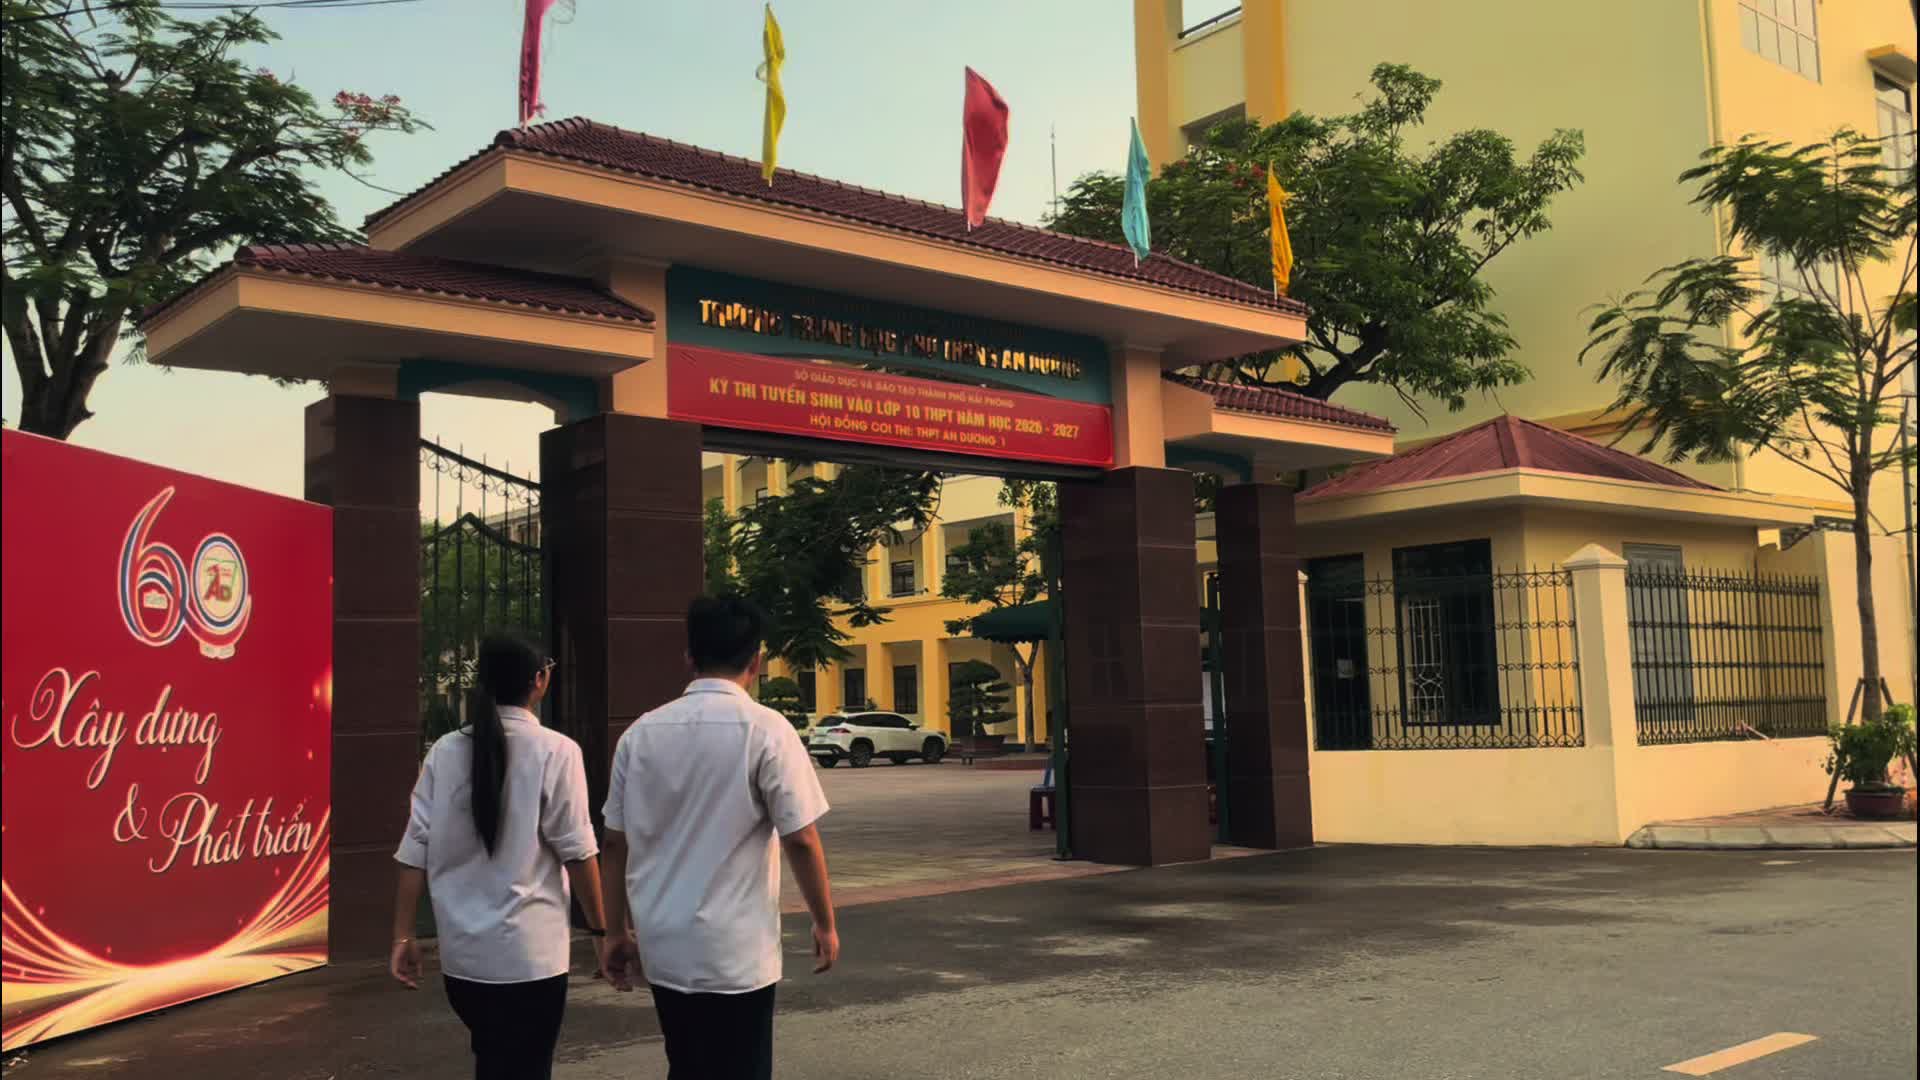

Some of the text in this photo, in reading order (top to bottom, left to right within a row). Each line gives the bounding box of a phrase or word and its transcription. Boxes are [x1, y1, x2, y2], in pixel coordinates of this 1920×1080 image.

[1001, 348, 1026, 371] AN
[733, 381, 757, 400] THI
[809, 391, 843, 409] SINH
[905, 404, 920, 419] 10
[924, 405, 953, 425] THPT
[956, 408, 986, 428] NĂM
[988, 413, 1012, 433] HỌC
[1052, 422, 1081, 440] 2027
[870, 421, 892, 434] COI
[916, 426, 940, 440] THPT
[943, 430, 958, 442] AN
[11, 667, 223, 789] Xây dựng
[113, 783, 314, 874] & Phát triển
